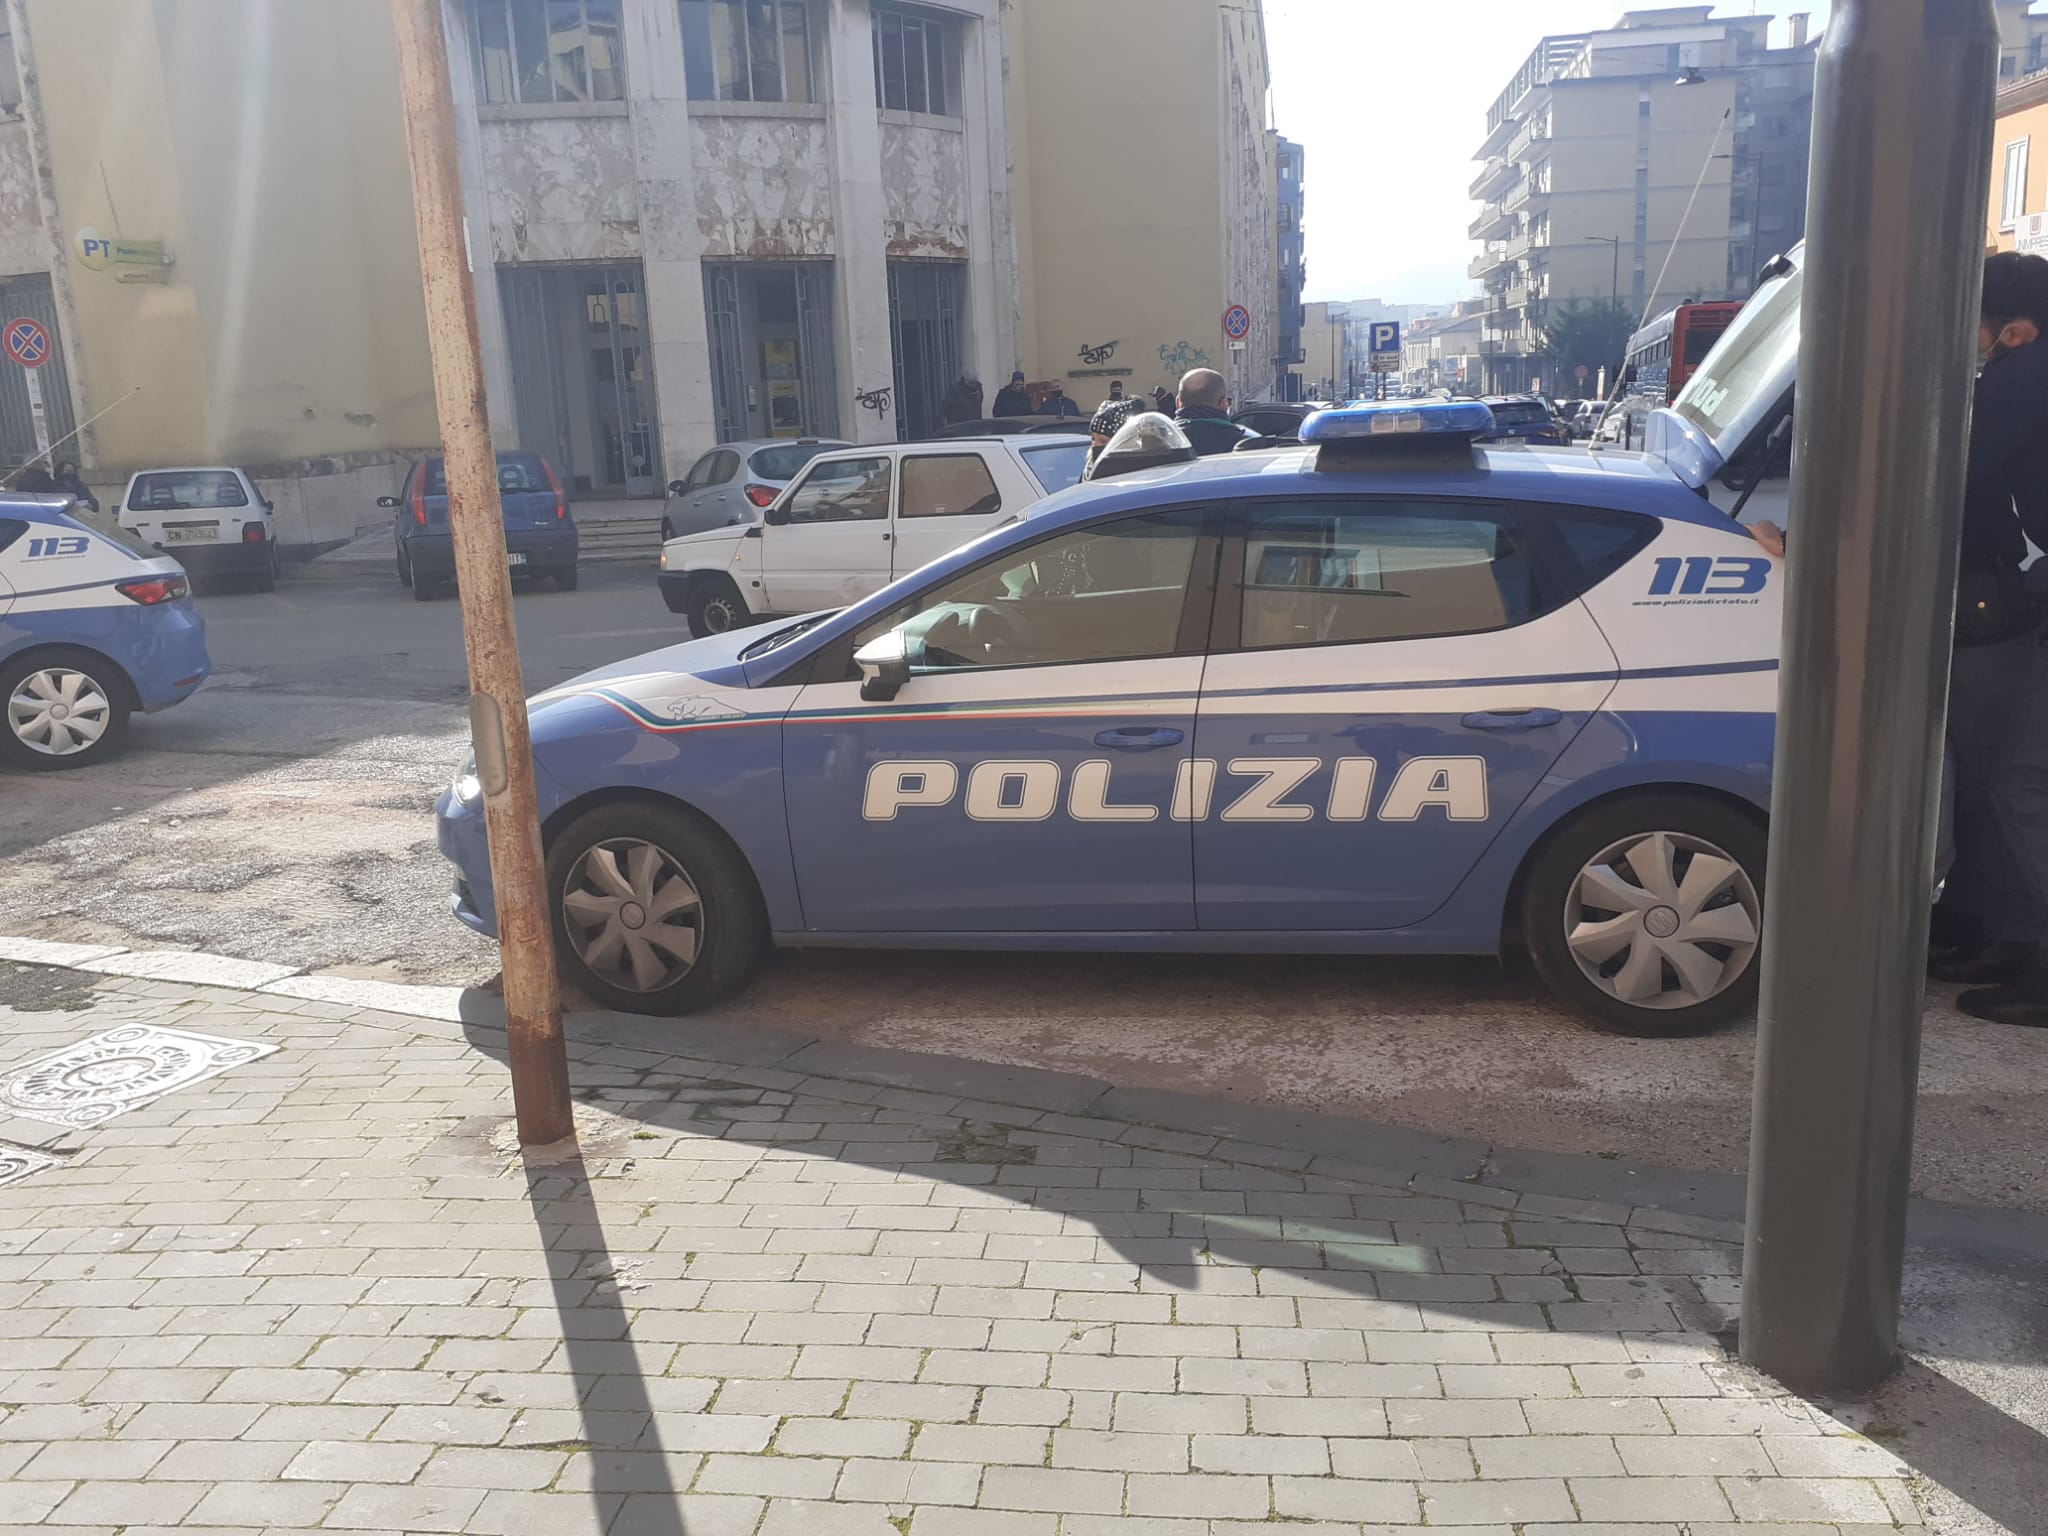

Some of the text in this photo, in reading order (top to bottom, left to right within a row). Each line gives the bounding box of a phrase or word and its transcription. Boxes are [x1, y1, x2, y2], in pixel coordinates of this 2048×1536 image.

[83, 239, 110, 257] PT
[1375, 325, 1394, 350] P
[28, 536, 90, 557] 113
[1648, 557, 1772, 595] 113
[1632, 598, 1760, 607] www.poliziadistato.it
[862, 755, 1489, 822] POLIZIA
